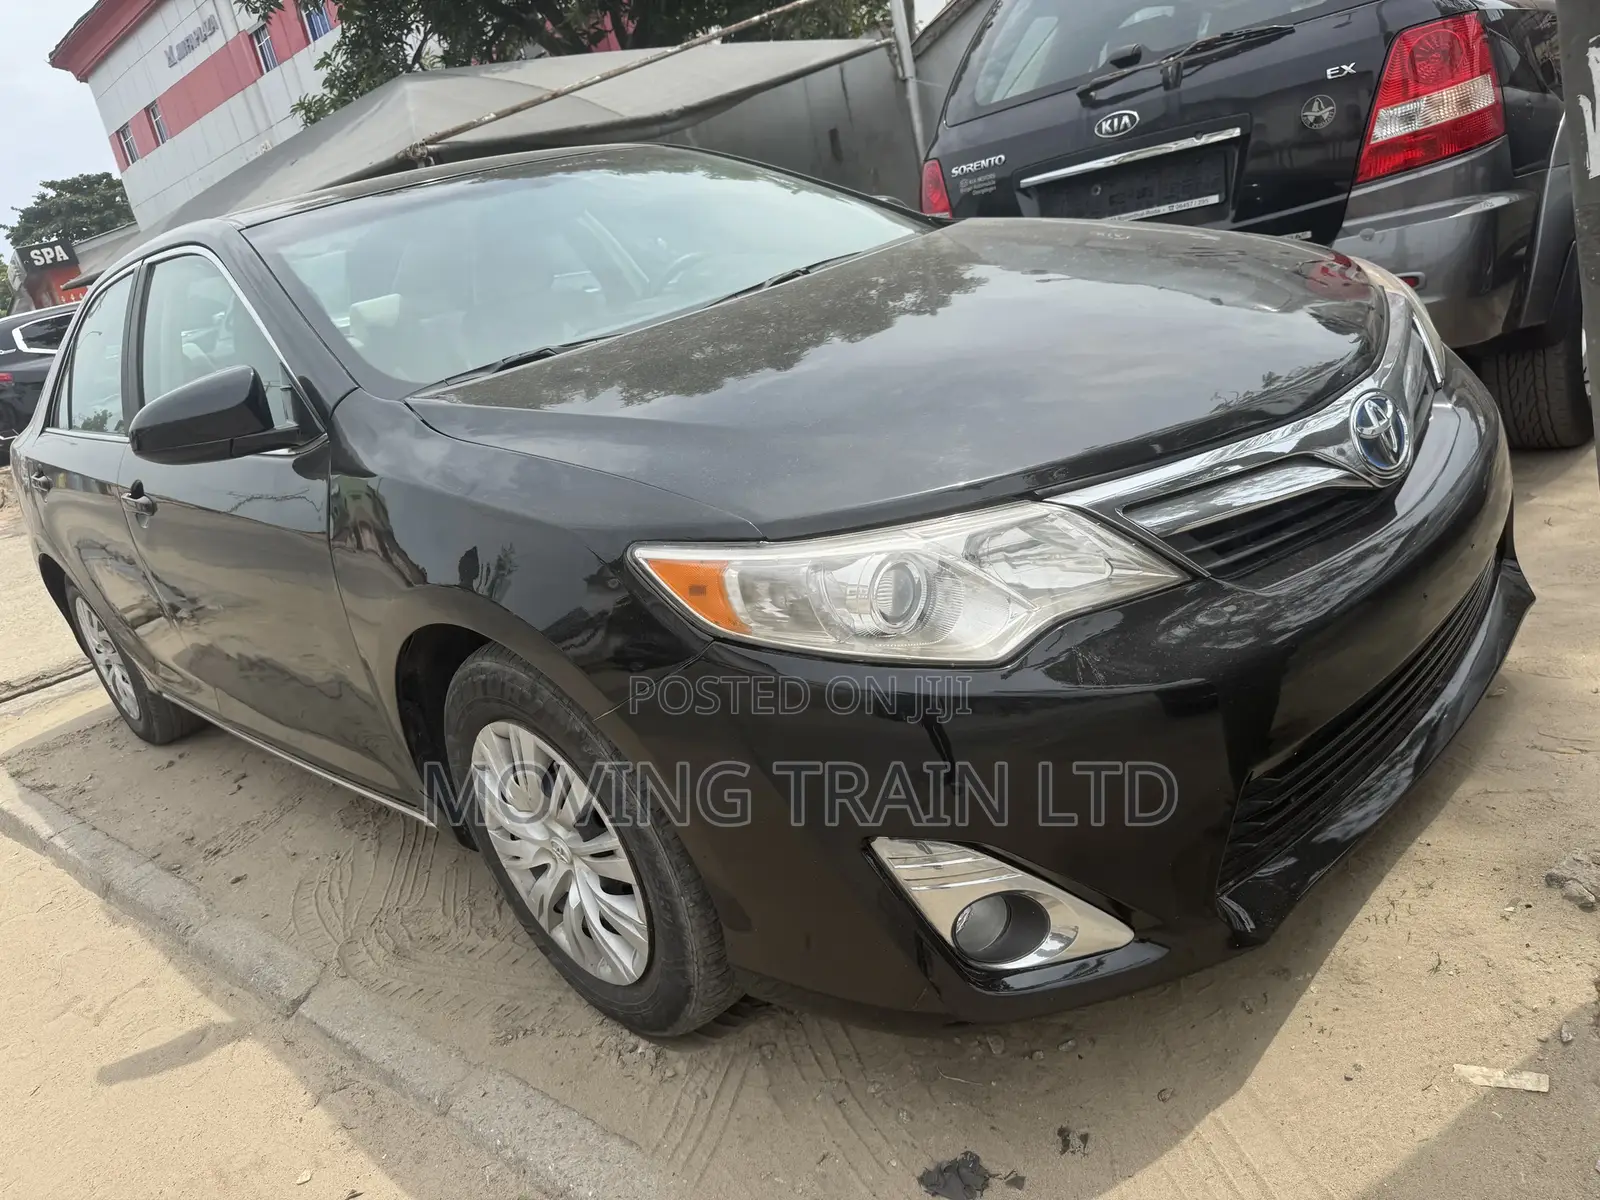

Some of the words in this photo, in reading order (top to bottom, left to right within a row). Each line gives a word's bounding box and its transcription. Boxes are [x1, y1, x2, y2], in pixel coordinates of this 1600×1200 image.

[1326, 62, 1357, 80] EX
[1101, 115, 1132, 134] KIA
[951, 154, 1006, 178] SORENTO
[30, 245, 69, 266] SPA
